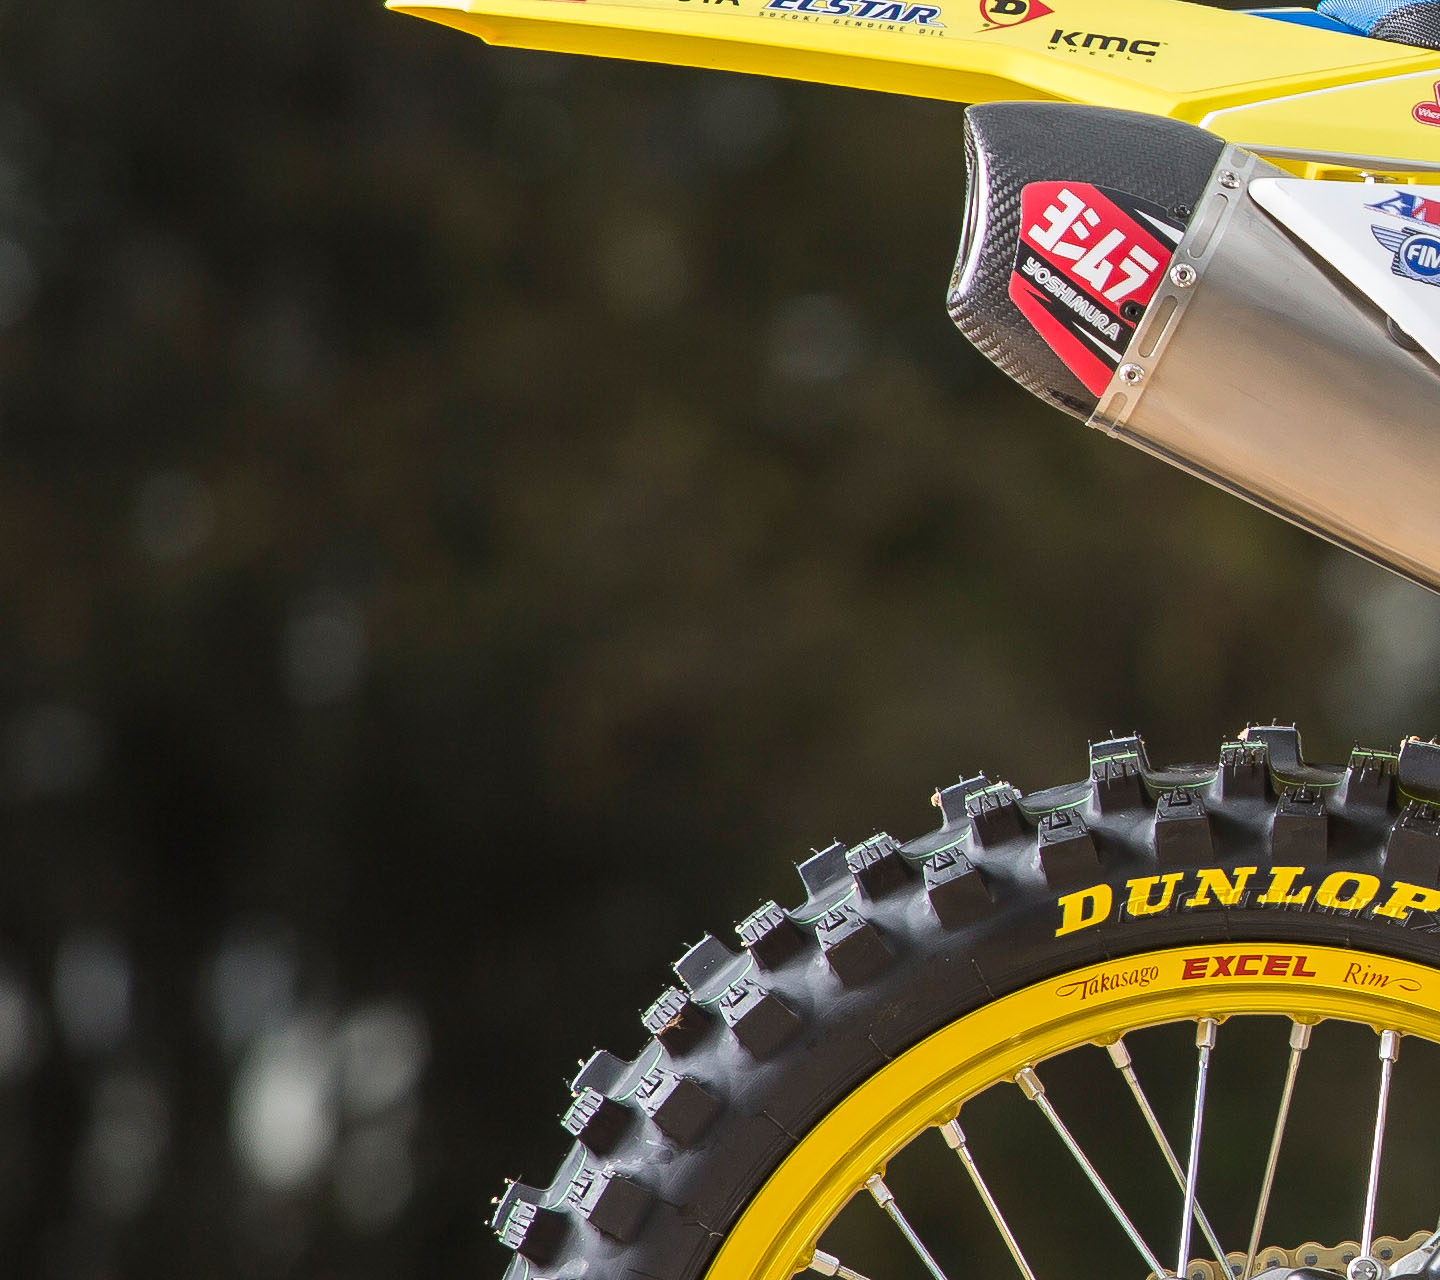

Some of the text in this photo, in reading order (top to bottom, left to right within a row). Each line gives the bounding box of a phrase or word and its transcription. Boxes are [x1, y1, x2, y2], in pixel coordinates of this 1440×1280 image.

[1047, 45, 1152, 63] WHEELS
[1027, 187, 1159, 305] ヨシムラ
[1022, 256, 1124, 342] YOSHIMURA
[1055, 954, 1423, 1001] Takasago EXCEL Rim
